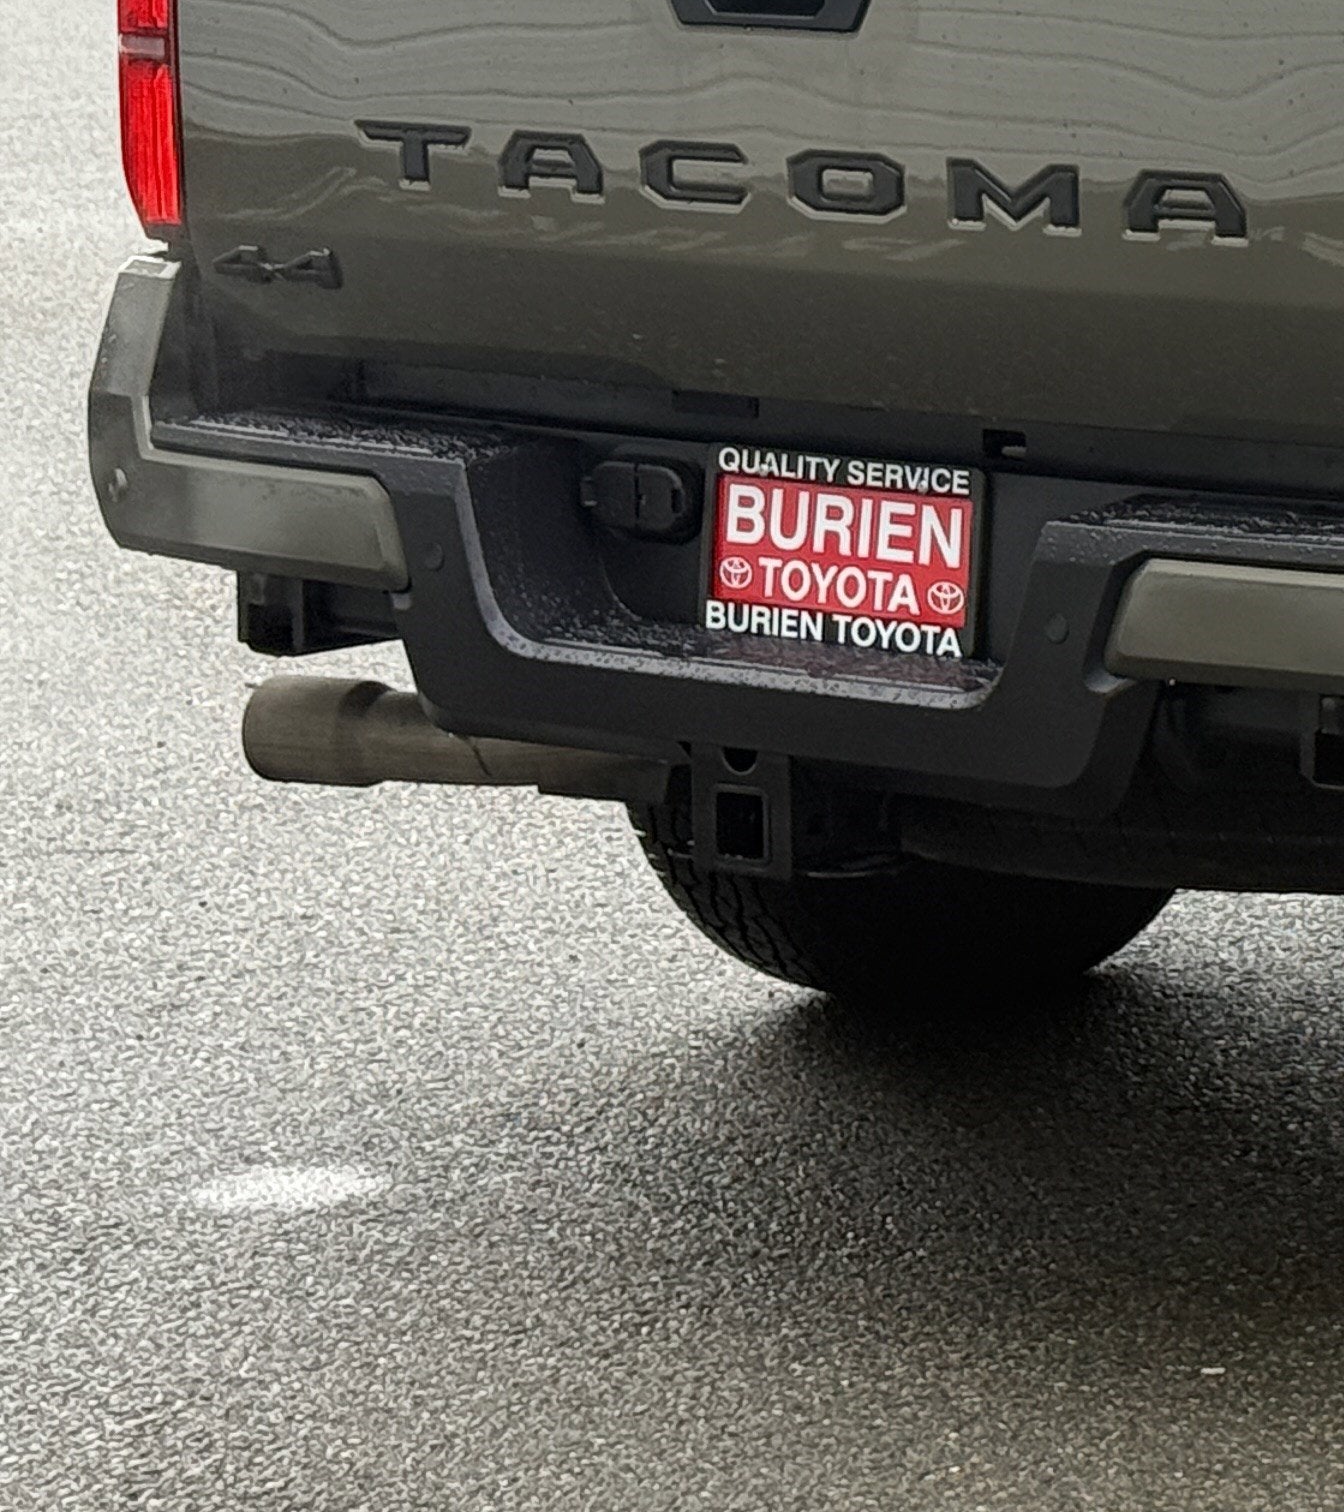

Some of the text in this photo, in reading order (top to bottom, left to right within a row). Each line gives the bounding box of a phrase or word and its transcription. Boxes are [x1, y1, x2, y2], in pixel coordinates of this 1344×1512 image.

[352, 117, 1249, 247] TACOMA
[717, 446, 971, 496] QUALITY SERVICE
[725, 483, 964, 569] BURIEN
[758, 556, 921, 616] TOYOTA
[705, 600, 963, 659] BURIEN TOYOTA
